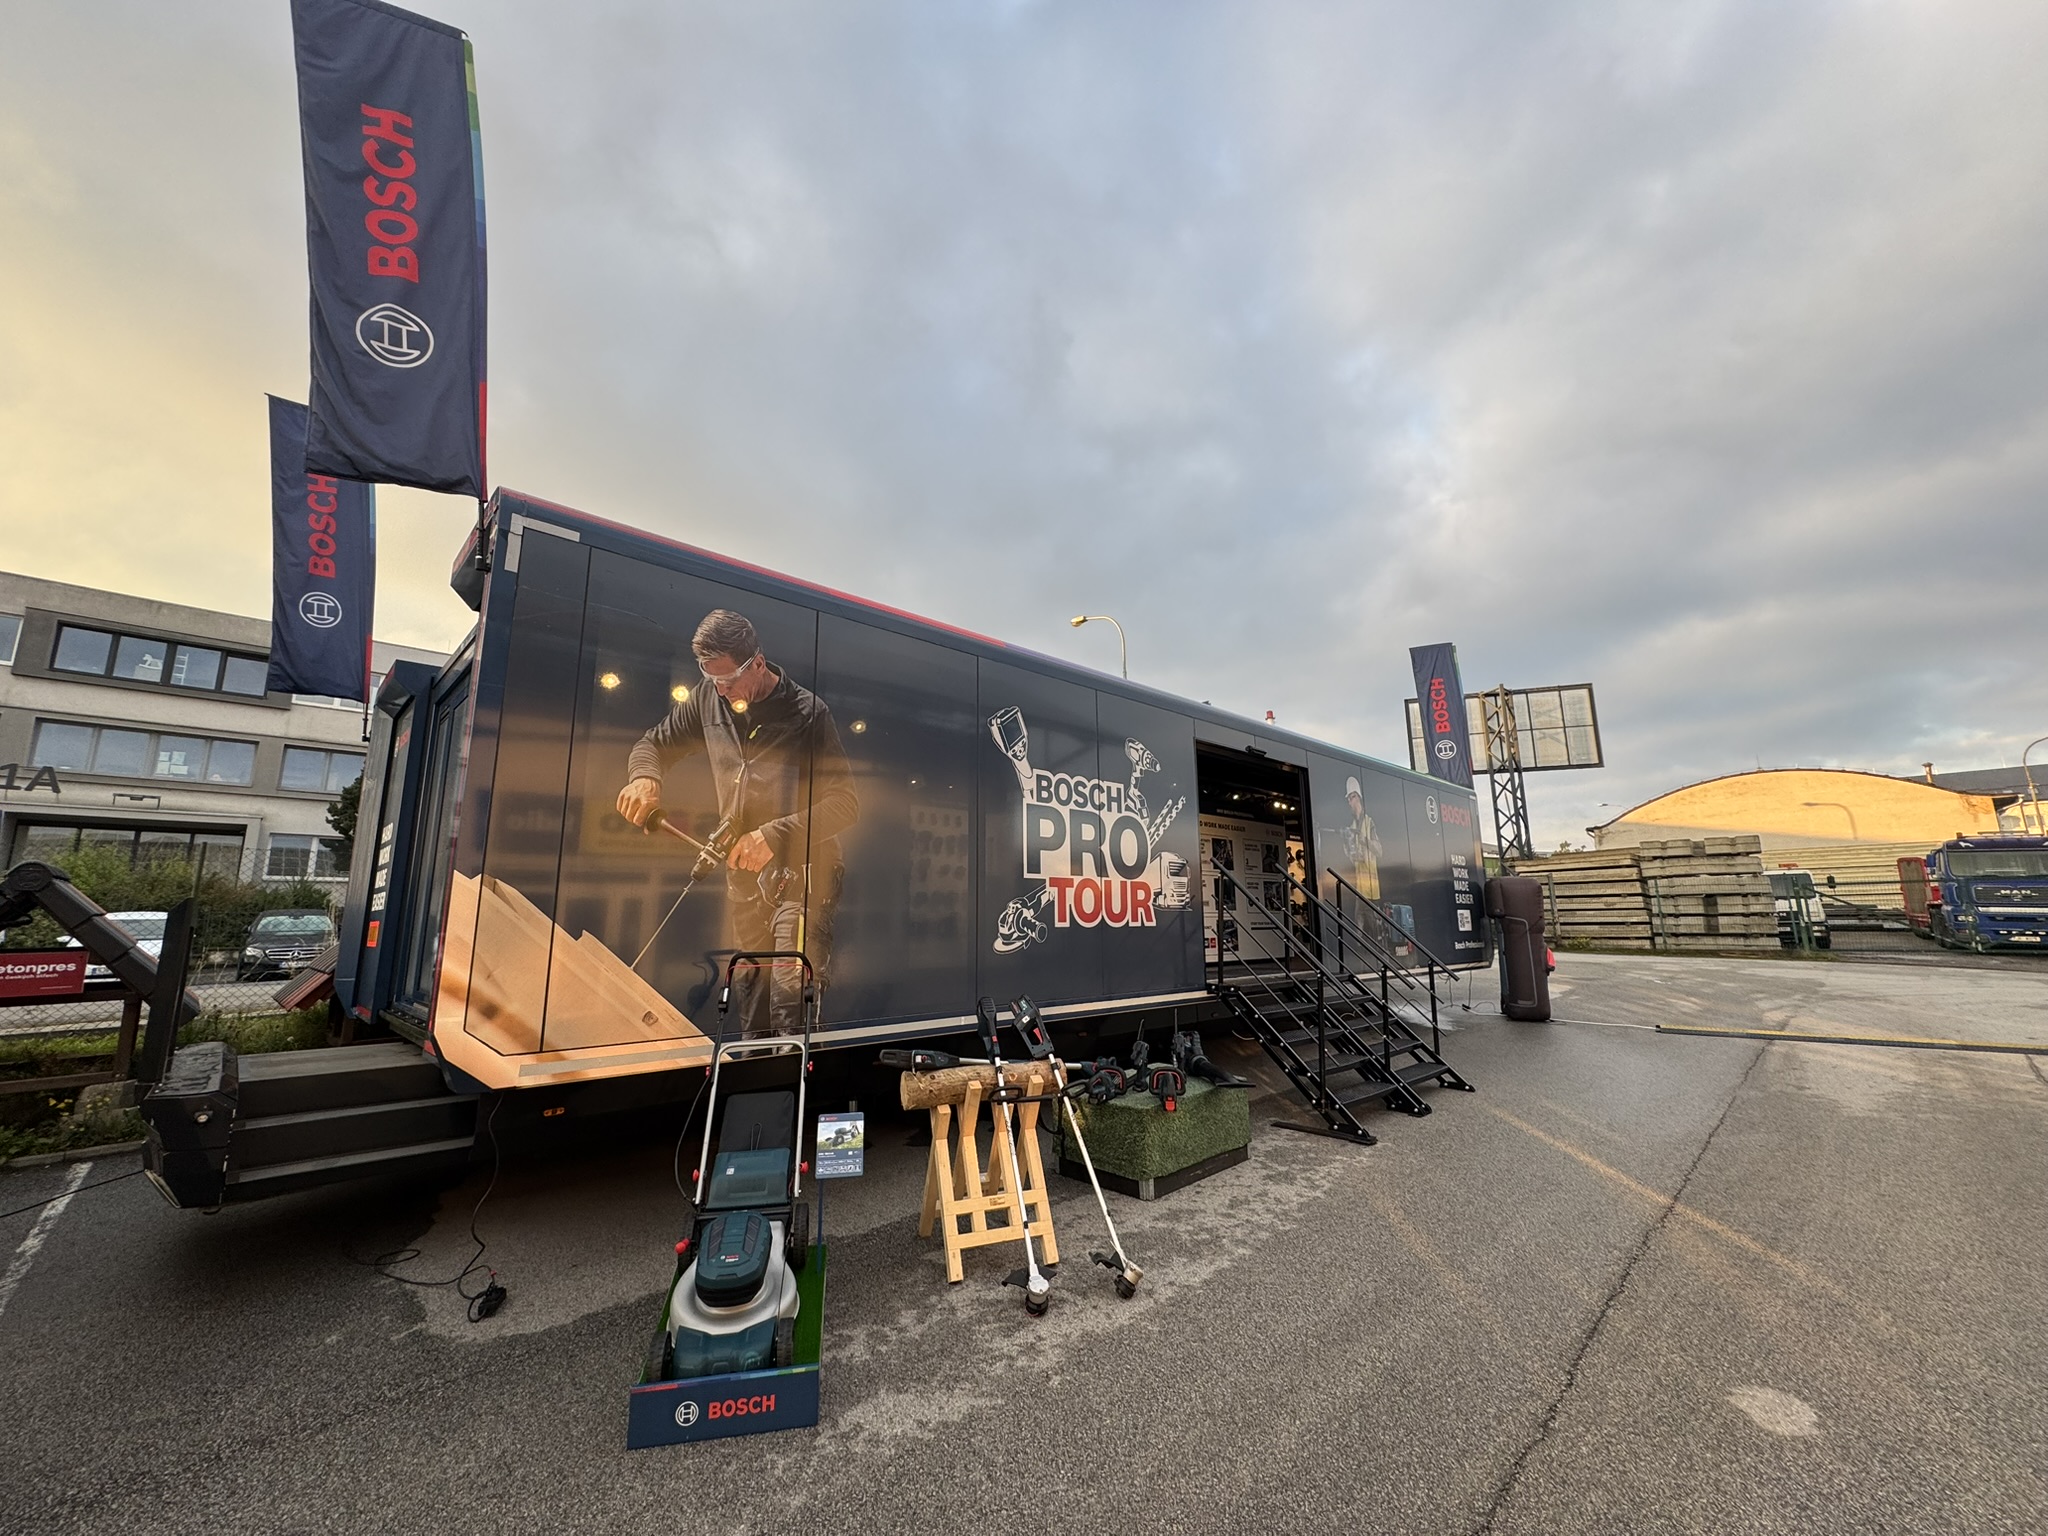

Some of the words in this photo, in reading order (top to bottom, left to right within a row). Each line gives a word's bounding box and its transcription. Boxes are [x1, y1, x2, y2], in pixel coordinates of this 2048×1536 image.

[361, 103, 419, 283] BOSCH
[307, 473, 338, 578] BOSCH
[1431, 678, 1451, 733] BOSCH
[1036, 774, 1122, 814] BOSCH
[1218, 823, 1230, 831] MADE
[1440, 803, 1471, 828] BOSCH
[1026, 803, 1148, 880] PRO
[1450, 854, 1467, 866] HARD
[1452, 867, 1469, 879] WORK
[1453, 880, 1469, 891] MADE
[1050, 877, 1153, 923] TOUR
[1455, 893, 1475, 905] EASIER
[2000, 889, 2031, 897] MAN
[708, 1394, 776, 1420] BOSCH
